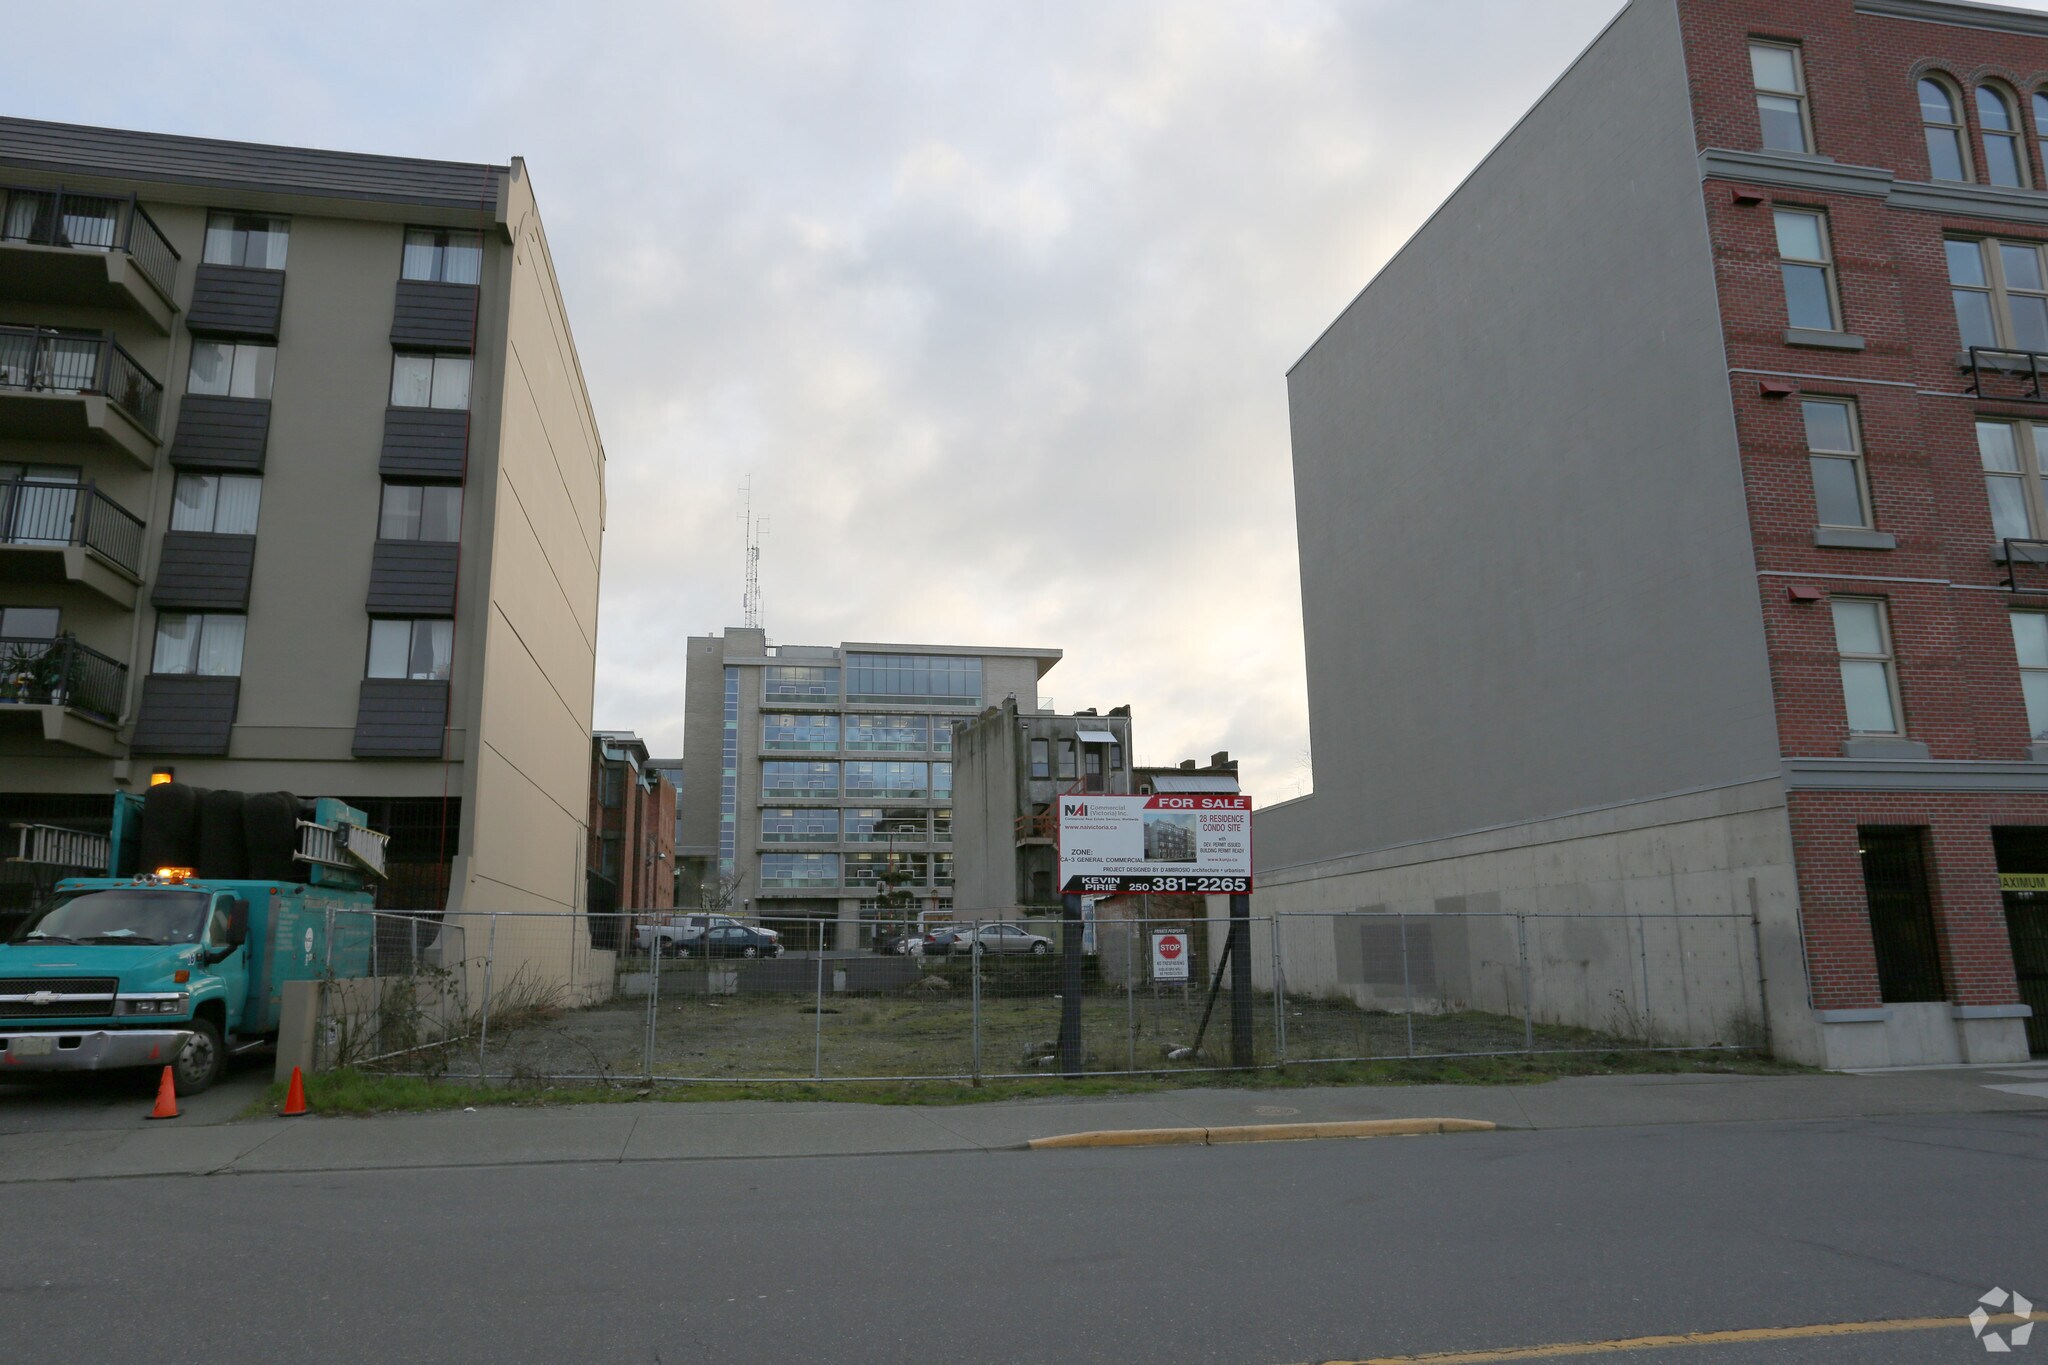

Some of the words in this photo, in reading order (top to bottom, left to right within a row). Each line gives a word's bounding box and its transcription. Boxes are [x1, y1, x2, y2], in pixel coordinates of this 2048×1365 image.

[1064, 802, 1088, 816] NAI
[1158, 798, 1194, 808] FOR
[1201, 799, 1245, 809] SALE
[1199, 815, 1208, 823] 28
[1209, 815, 1244, 823] RESIDENCE
[1202, 823, 1226, 832] CONDO
[1227, 823, 1241, 832] SITE
[1129, 883, 1149, 891] 250
[1152, 877, 1247, 891] 381-2265
